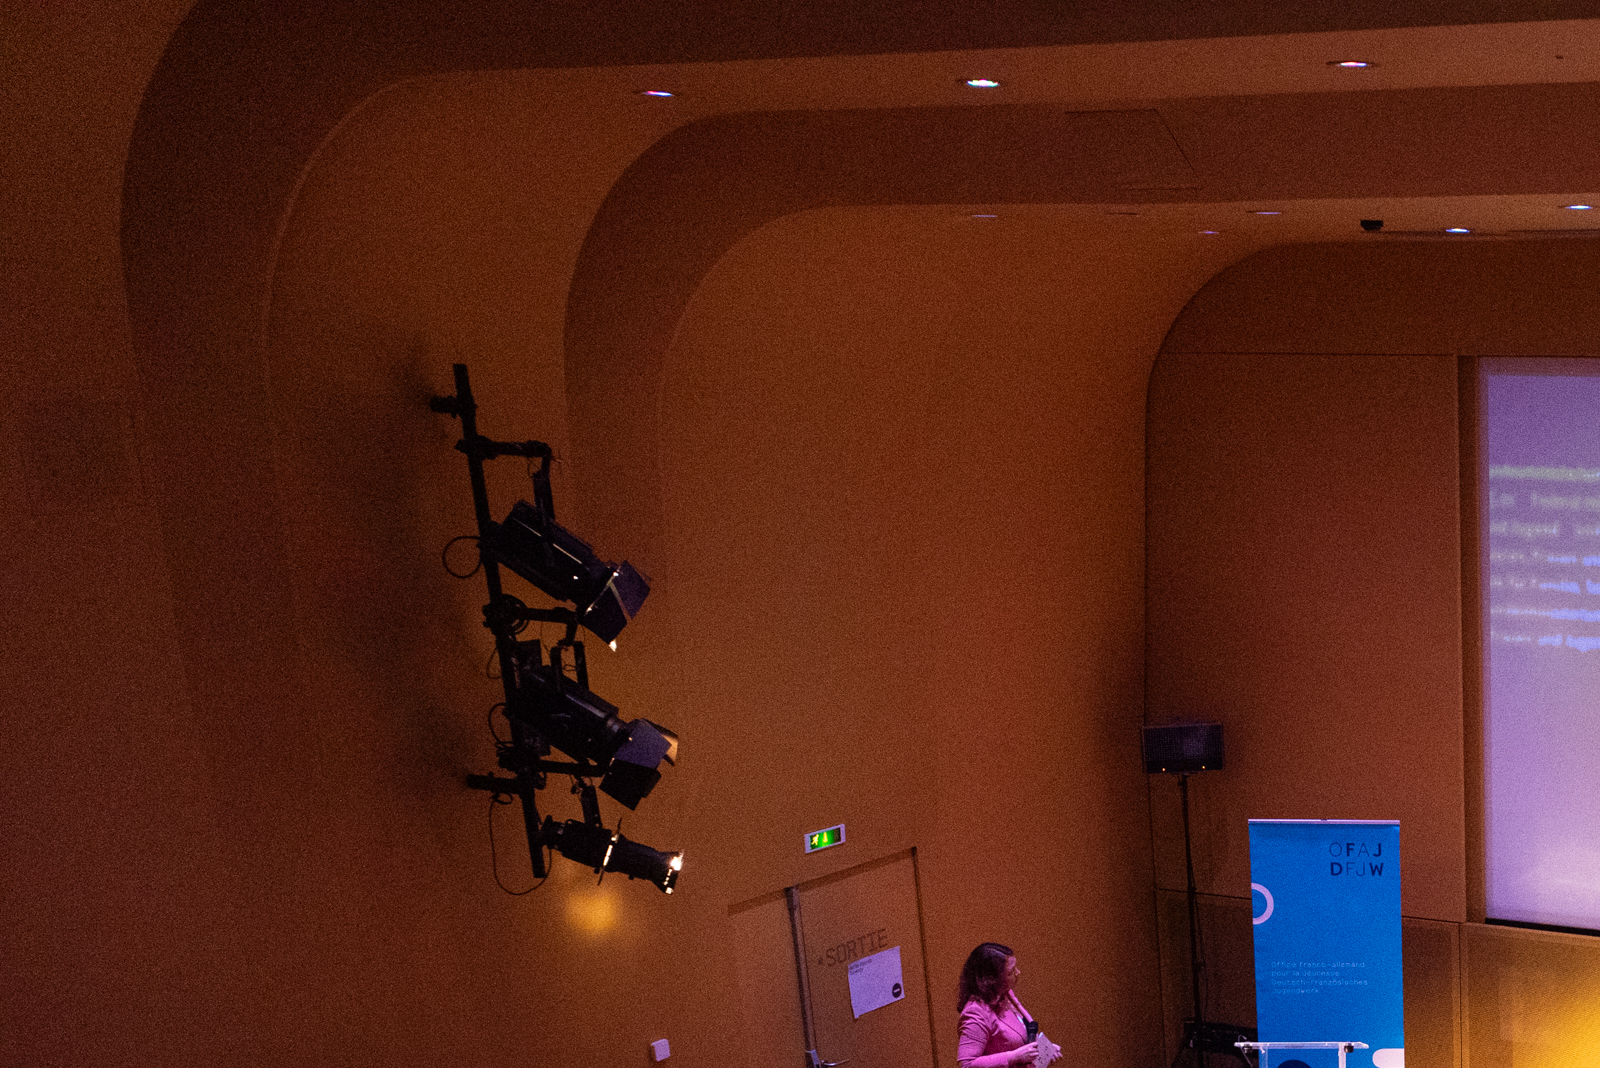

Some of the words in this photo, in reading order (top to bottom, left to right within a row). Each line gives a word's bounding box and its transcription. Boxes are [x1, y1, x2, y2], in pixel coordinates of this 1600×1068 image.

[1329, 842, 1382, 857] OFAJ
[1330, 861, 1384, 877] DFJW
[826, 928, 888, 967] SORTIE
